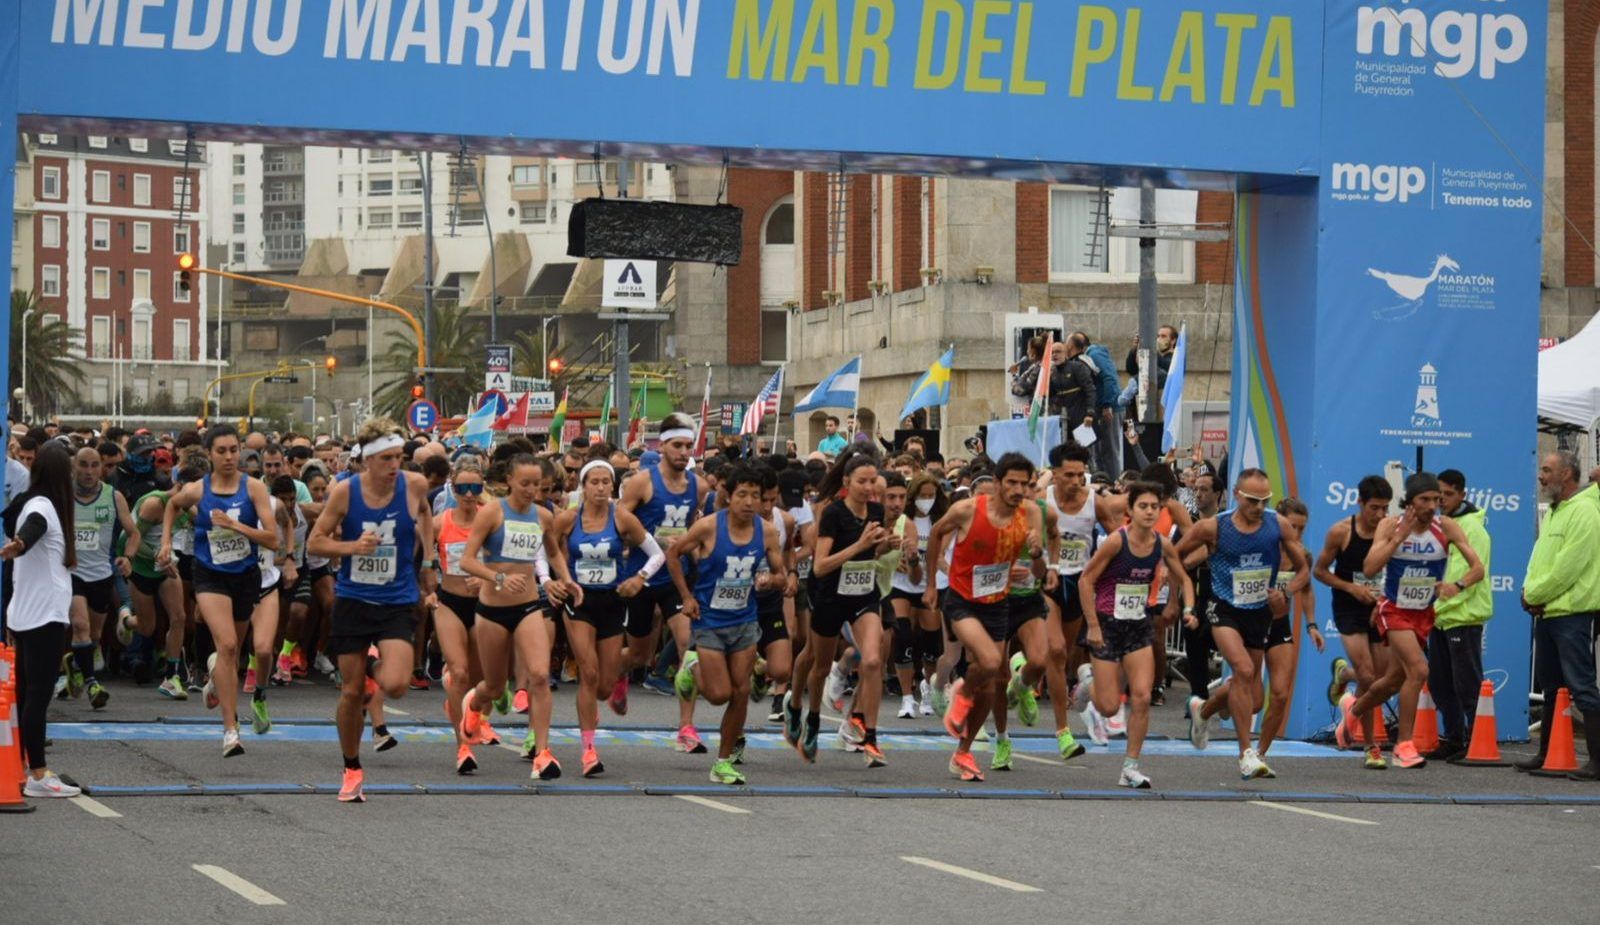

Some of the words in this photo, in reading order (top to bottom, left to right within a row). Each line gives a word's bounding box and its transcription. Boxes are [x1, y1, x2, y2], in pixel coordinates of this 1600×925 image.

[1356, 6, 1528, 80] mgp
[726, 0, 896, 88] MAR
[913, 0, 1047, 96] DEL
[1069, 4, 1296, 108] PLATA
[1355, 60, 1427, 75] Municipalidad
[1355, 72, 1369, 83] de
[1371, 72, 1411, 85] General
[1442, 168, 1501, 180] Municipalidad
[1503, 172, 1515, 180] de
[1331, 162, 1426, 203] mgp
[1442, 178, 1476, 189] General
[1442, 193, 1499, 207] Tenemos
[1502, 196, 1533, 209] todo
[1438, 273, 1495, 287] MARATÓN
[1438, 285, 1455, 293] MAR
[416, 406, 429, 426] E
[214, 536, 246, 554] 3525
[510, 533, 538, 550] 4812
[1402, 541, 1435, 554] FILA
[358, 557, 389, 573] 2910
[588, 569, 604, 584] 22
[844, 571, 872, 586] 5366
[1238, 579, 1266, 596] 3995
[1402, 587, 1431, 600] 4057
